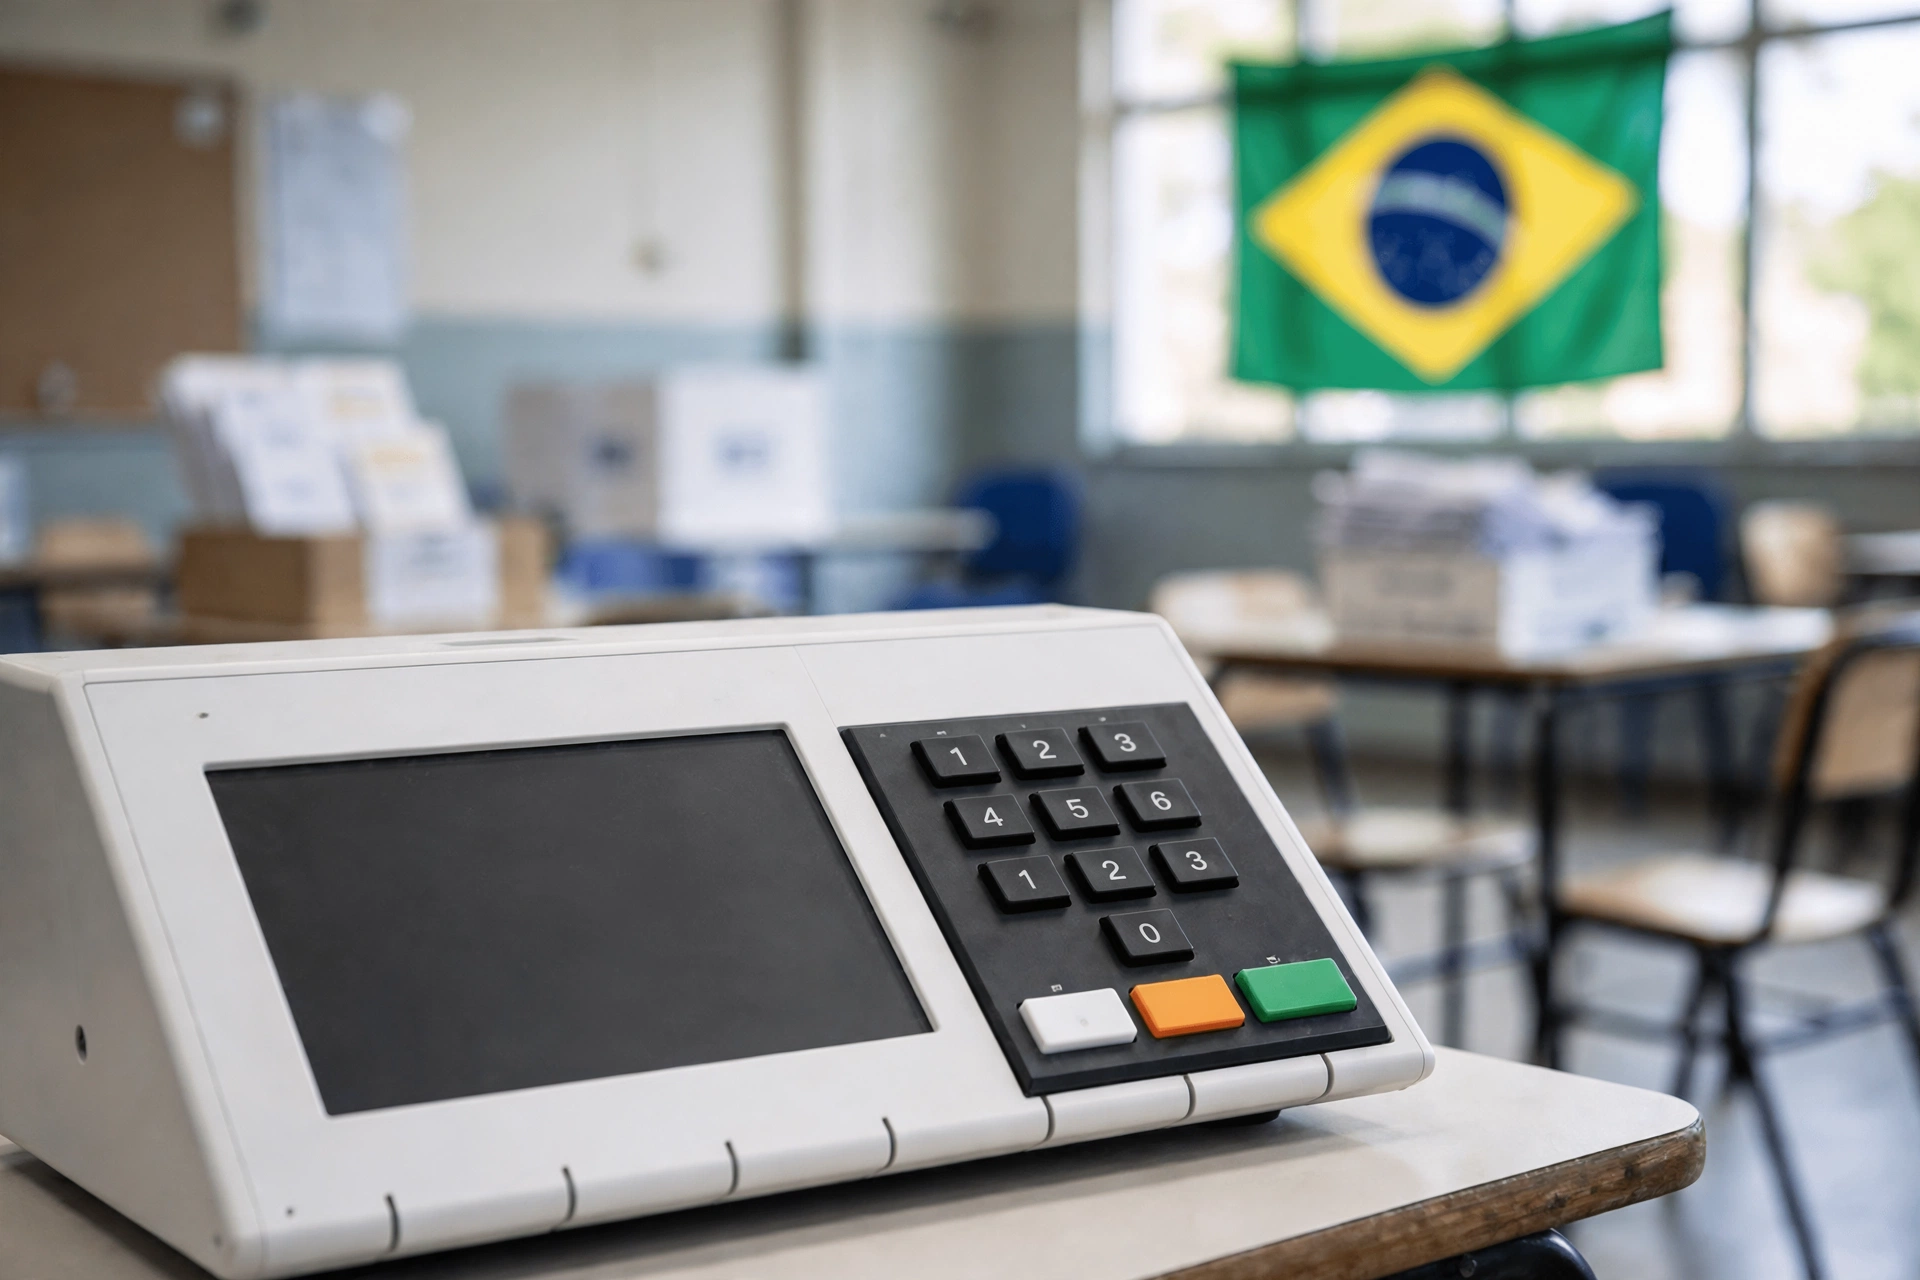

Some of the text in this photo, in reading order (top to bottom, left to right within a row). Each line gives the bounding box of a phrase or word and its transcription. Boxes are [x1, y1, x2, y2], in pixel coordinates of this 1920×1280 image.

[950, 733, 1137, 765] 1 2 3
[984, 791, 1171, 826] 4 5 6
[1019, 851, 1207, 889] 1 2 3
[1139, 923, 1160, 943] 0
